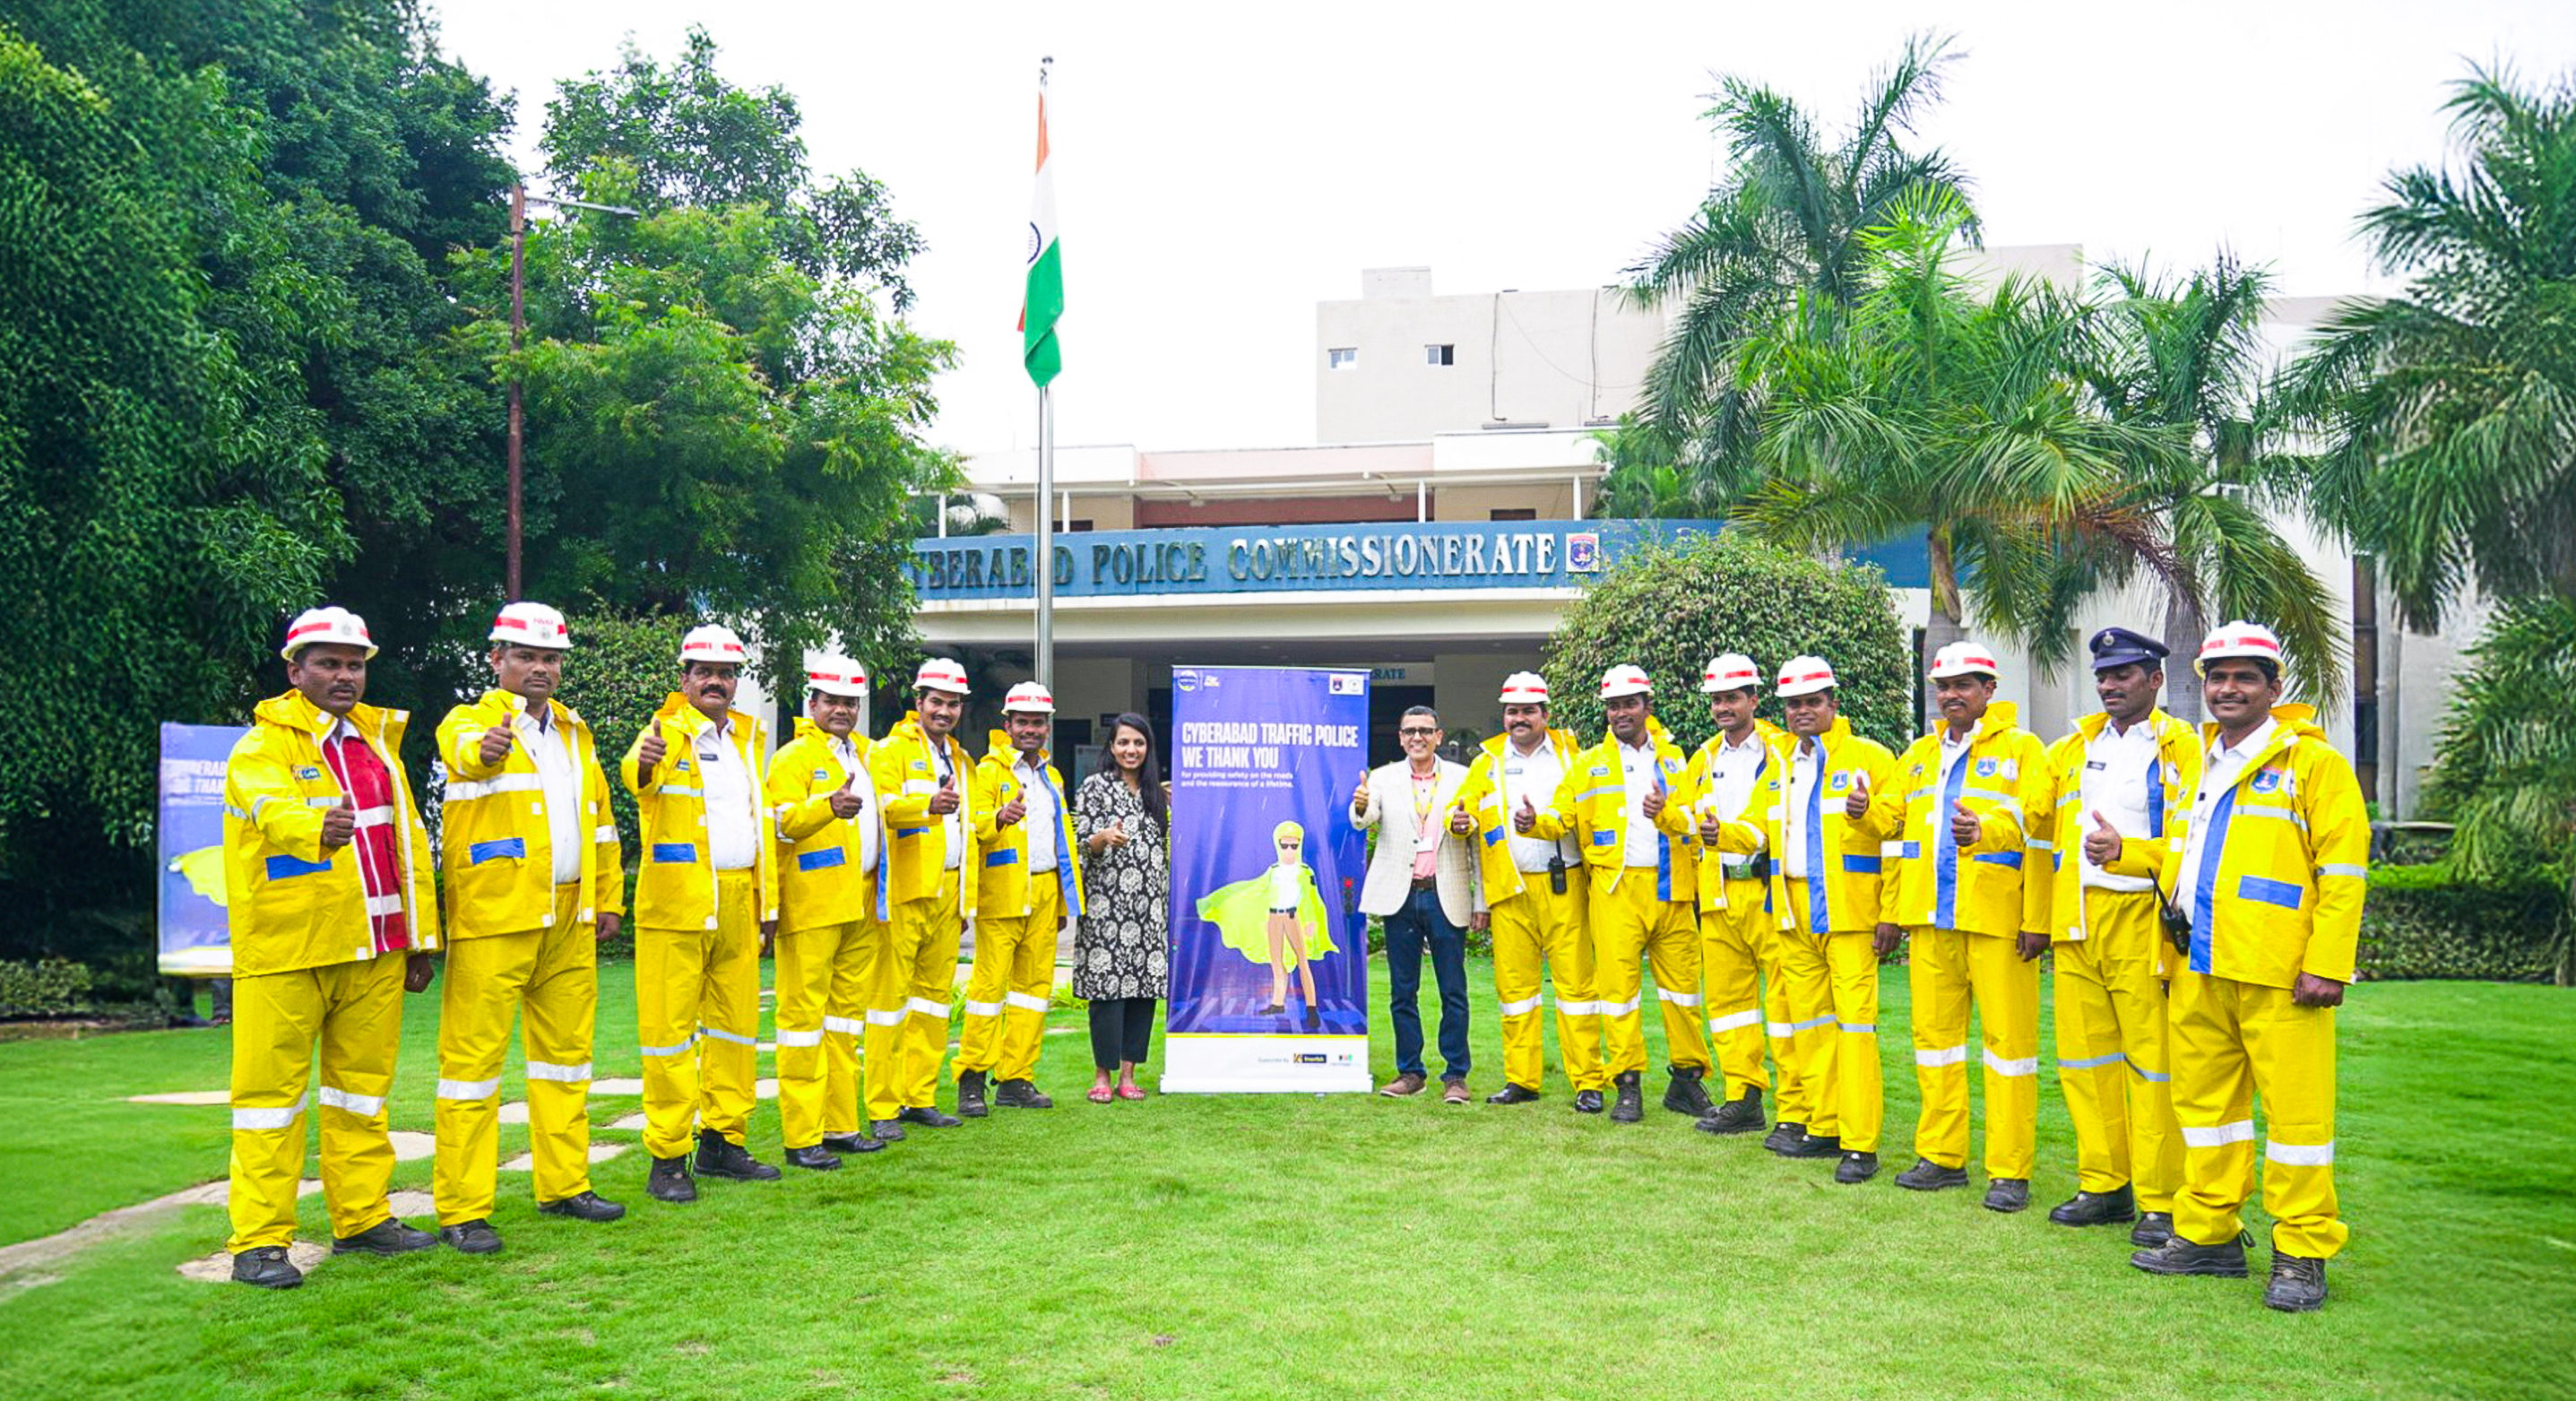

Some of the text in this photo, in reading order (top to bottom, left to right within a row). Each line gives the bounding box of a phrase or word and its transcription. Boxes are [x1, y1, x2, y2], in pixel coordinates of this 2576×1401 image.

[1092, 540, 1207, 584] POLICE
[1227, 532, 1558, 581] COMMISSIONERATE
[1182, 722, 1359, 748] CYBERABAD TRAFFIC POLICE
[1181, 746, 1279, 768] WE THANK YOU
[1180, 770, 1192, 779] for
[1193, 771, 1226, 780] providing
[1227, 771, 1249, 780] safety
[1260, 772, 1273, 780] the
[1274, 772, 1294, 780] roads
[1180, 779, 1195, 787] and
[1196, 779, 1208, 787] the
